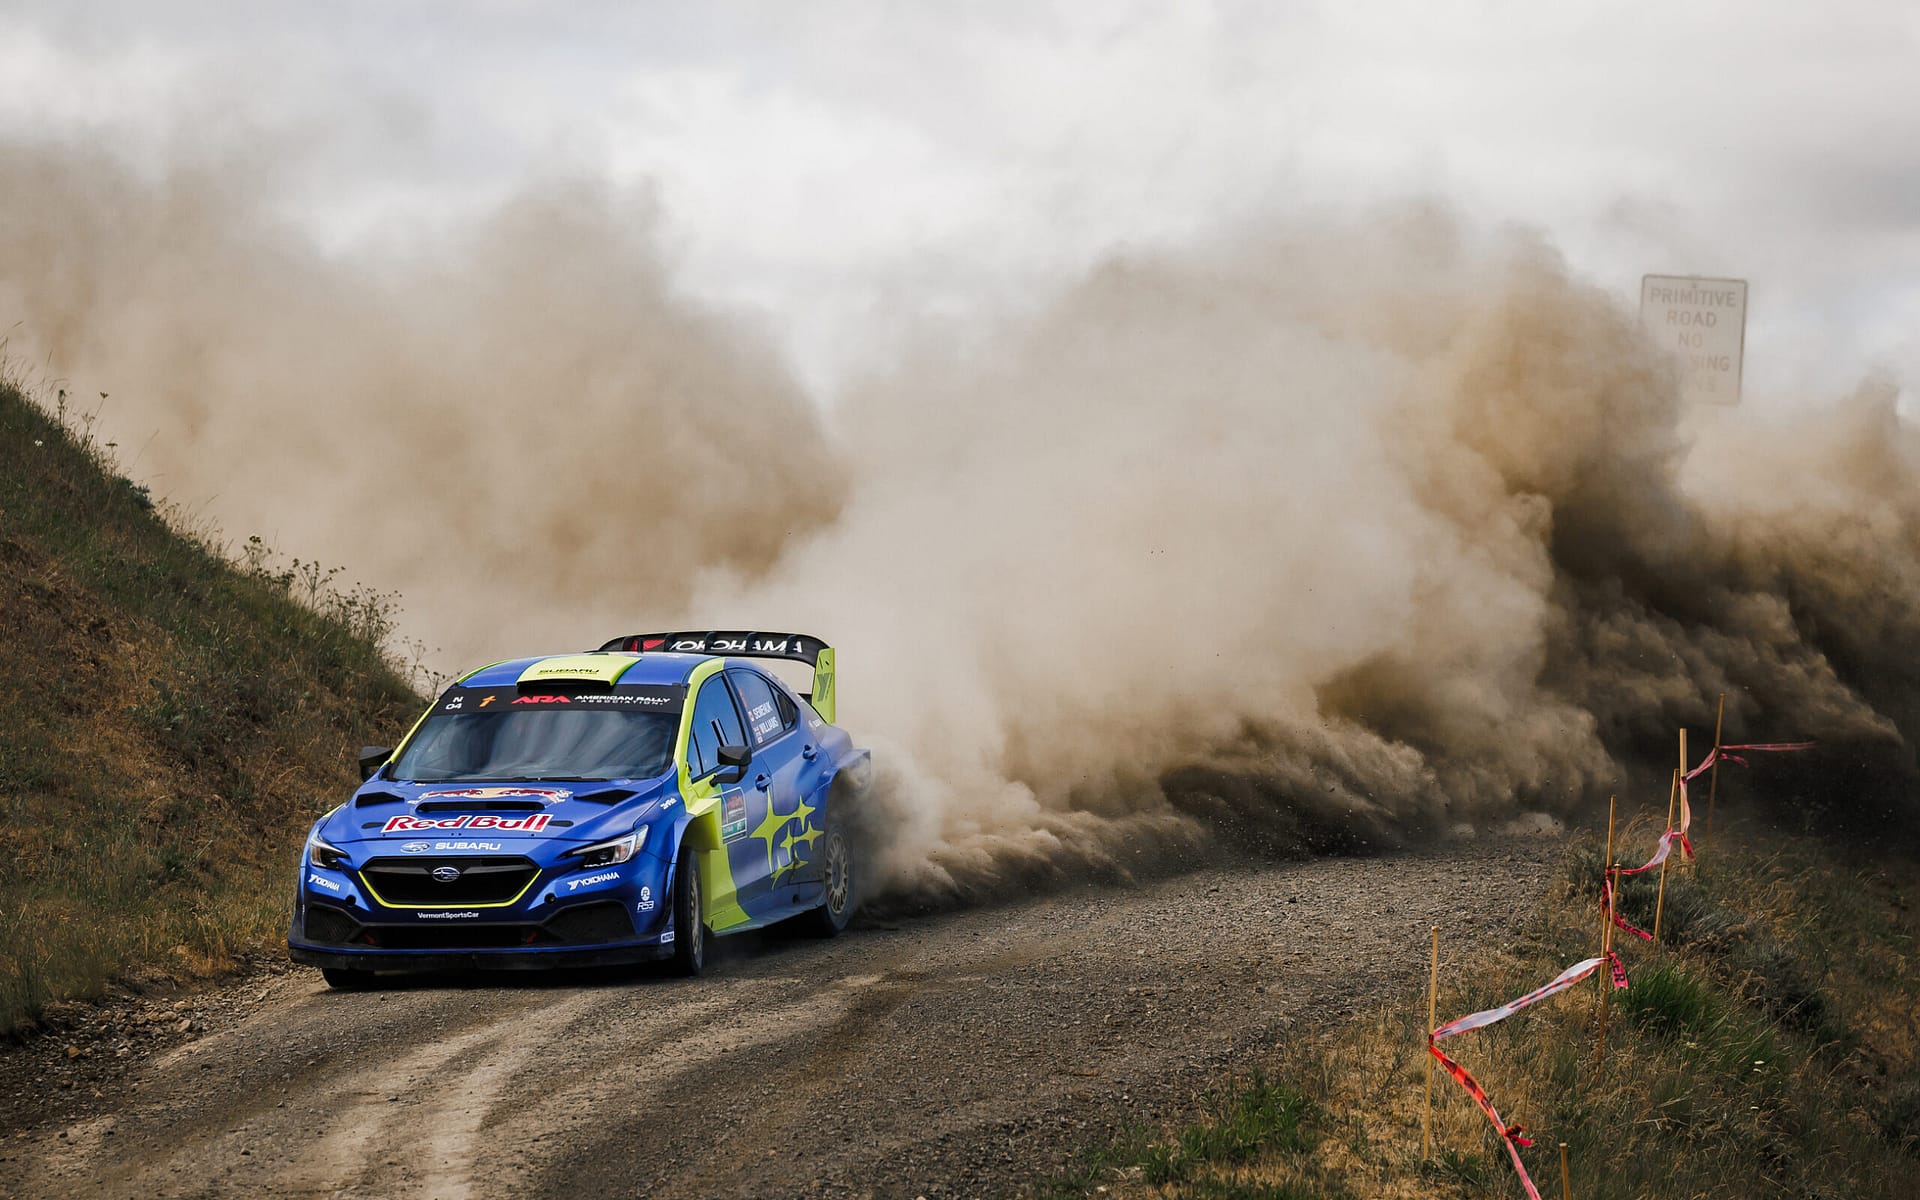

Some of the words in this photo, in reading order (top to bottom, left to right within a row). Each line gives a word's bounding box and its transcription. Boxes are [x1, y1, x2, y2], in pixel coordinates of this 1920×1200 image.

[1650, 288, 1736, 307] PRIMITIVE
[1666, 310, 1717, 328] ROAD
[1678, 332, 1703, 349] NO
[445, 702, 462, 710] 04
[511, 695, 571, 704] ARA
[381, 816, 470, 833] Red
[464, 813, 553, 832] Bull
[435, 842, 502, 851] SUBARU
[580, 872, 620, 887] YOKOHAMA
